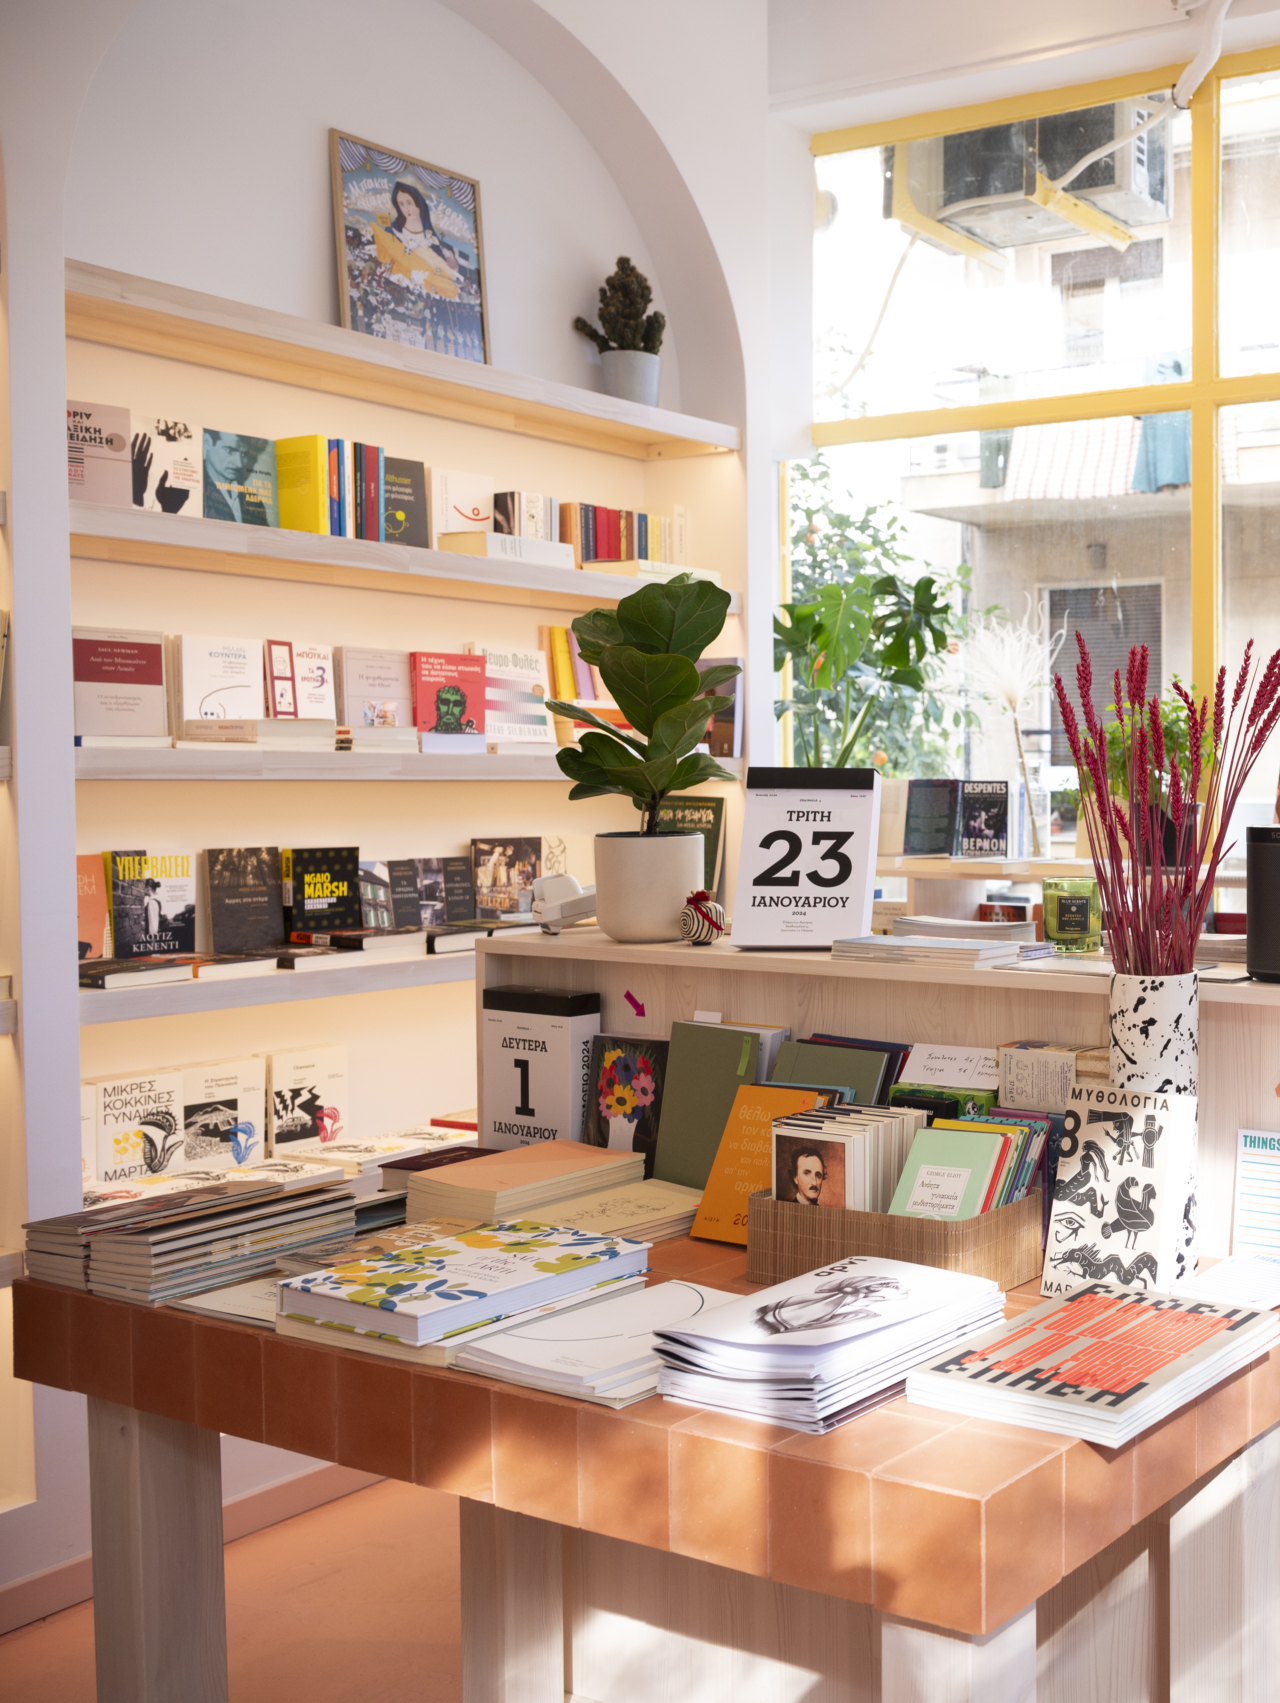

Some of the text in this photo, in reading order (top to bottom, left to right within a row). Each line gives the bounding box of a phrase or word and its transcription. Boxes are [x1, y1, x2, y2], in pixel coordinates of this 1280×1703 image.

[209, 652, 246, 660] ΚΟΥΝΤΕΡΑ
[312, 666, 326, 689] 3
[430, 669, 458, 677] άστατους
[507, 725, 547, 737] SILBERMAN
[964, 783, 1006, 793] DESPENTES
[787, 810, 831, 822] ΤΡΙΤΗ
[752, 830, 854, 888] 23
[116, 855, 191, 880] ΥΠΕΡΒΑΣΕΙΣ
[304, 872, 330, 884] NGAIO
[304, 881, 348, 899] MARSH
[751, 896, 849, 908] ΙΑΝΟΥΑΡΙΟΥ
[140, 932, 173, 942] ΛΟΥΙΖ
[132, 941, 179, 953] ΚΕΝΕΝΤΙ
[501, 1037, 548, 1053] ΔΕΥΤΕΡΑ
[582, 1040, 590, 1070] 2024
[103, 1080, 156, 1099] ΜΙΚΡΕΣ
[514, 1058, 535, 1117] 1
[103, 1091, 174, 1112] ΚΟΚΚΙΝΕΣ
[1071, 1087, 1169, 1111] ΜΥΘΟΛΟΓΙΑ
[103, 1104, 173, 1125] ΓΥΝΑΙΚΕΣ
[739, 1105, 771, 1121] θέλω
[493, 1121, 558, 1140] ΙΑΝΟΥΑΡΙΟΥ
[742, 1126, 758, 1135] τον
[1059, 1110, 1081, 1158] 8
[740, 1156, 770, 1166] και πάλι
[735, 1181, 763, 1194] αρχή
[931, 1192, 958, 1200] γυναικεία
[911, 1199, 955, 1211] μυθιστορήματα
